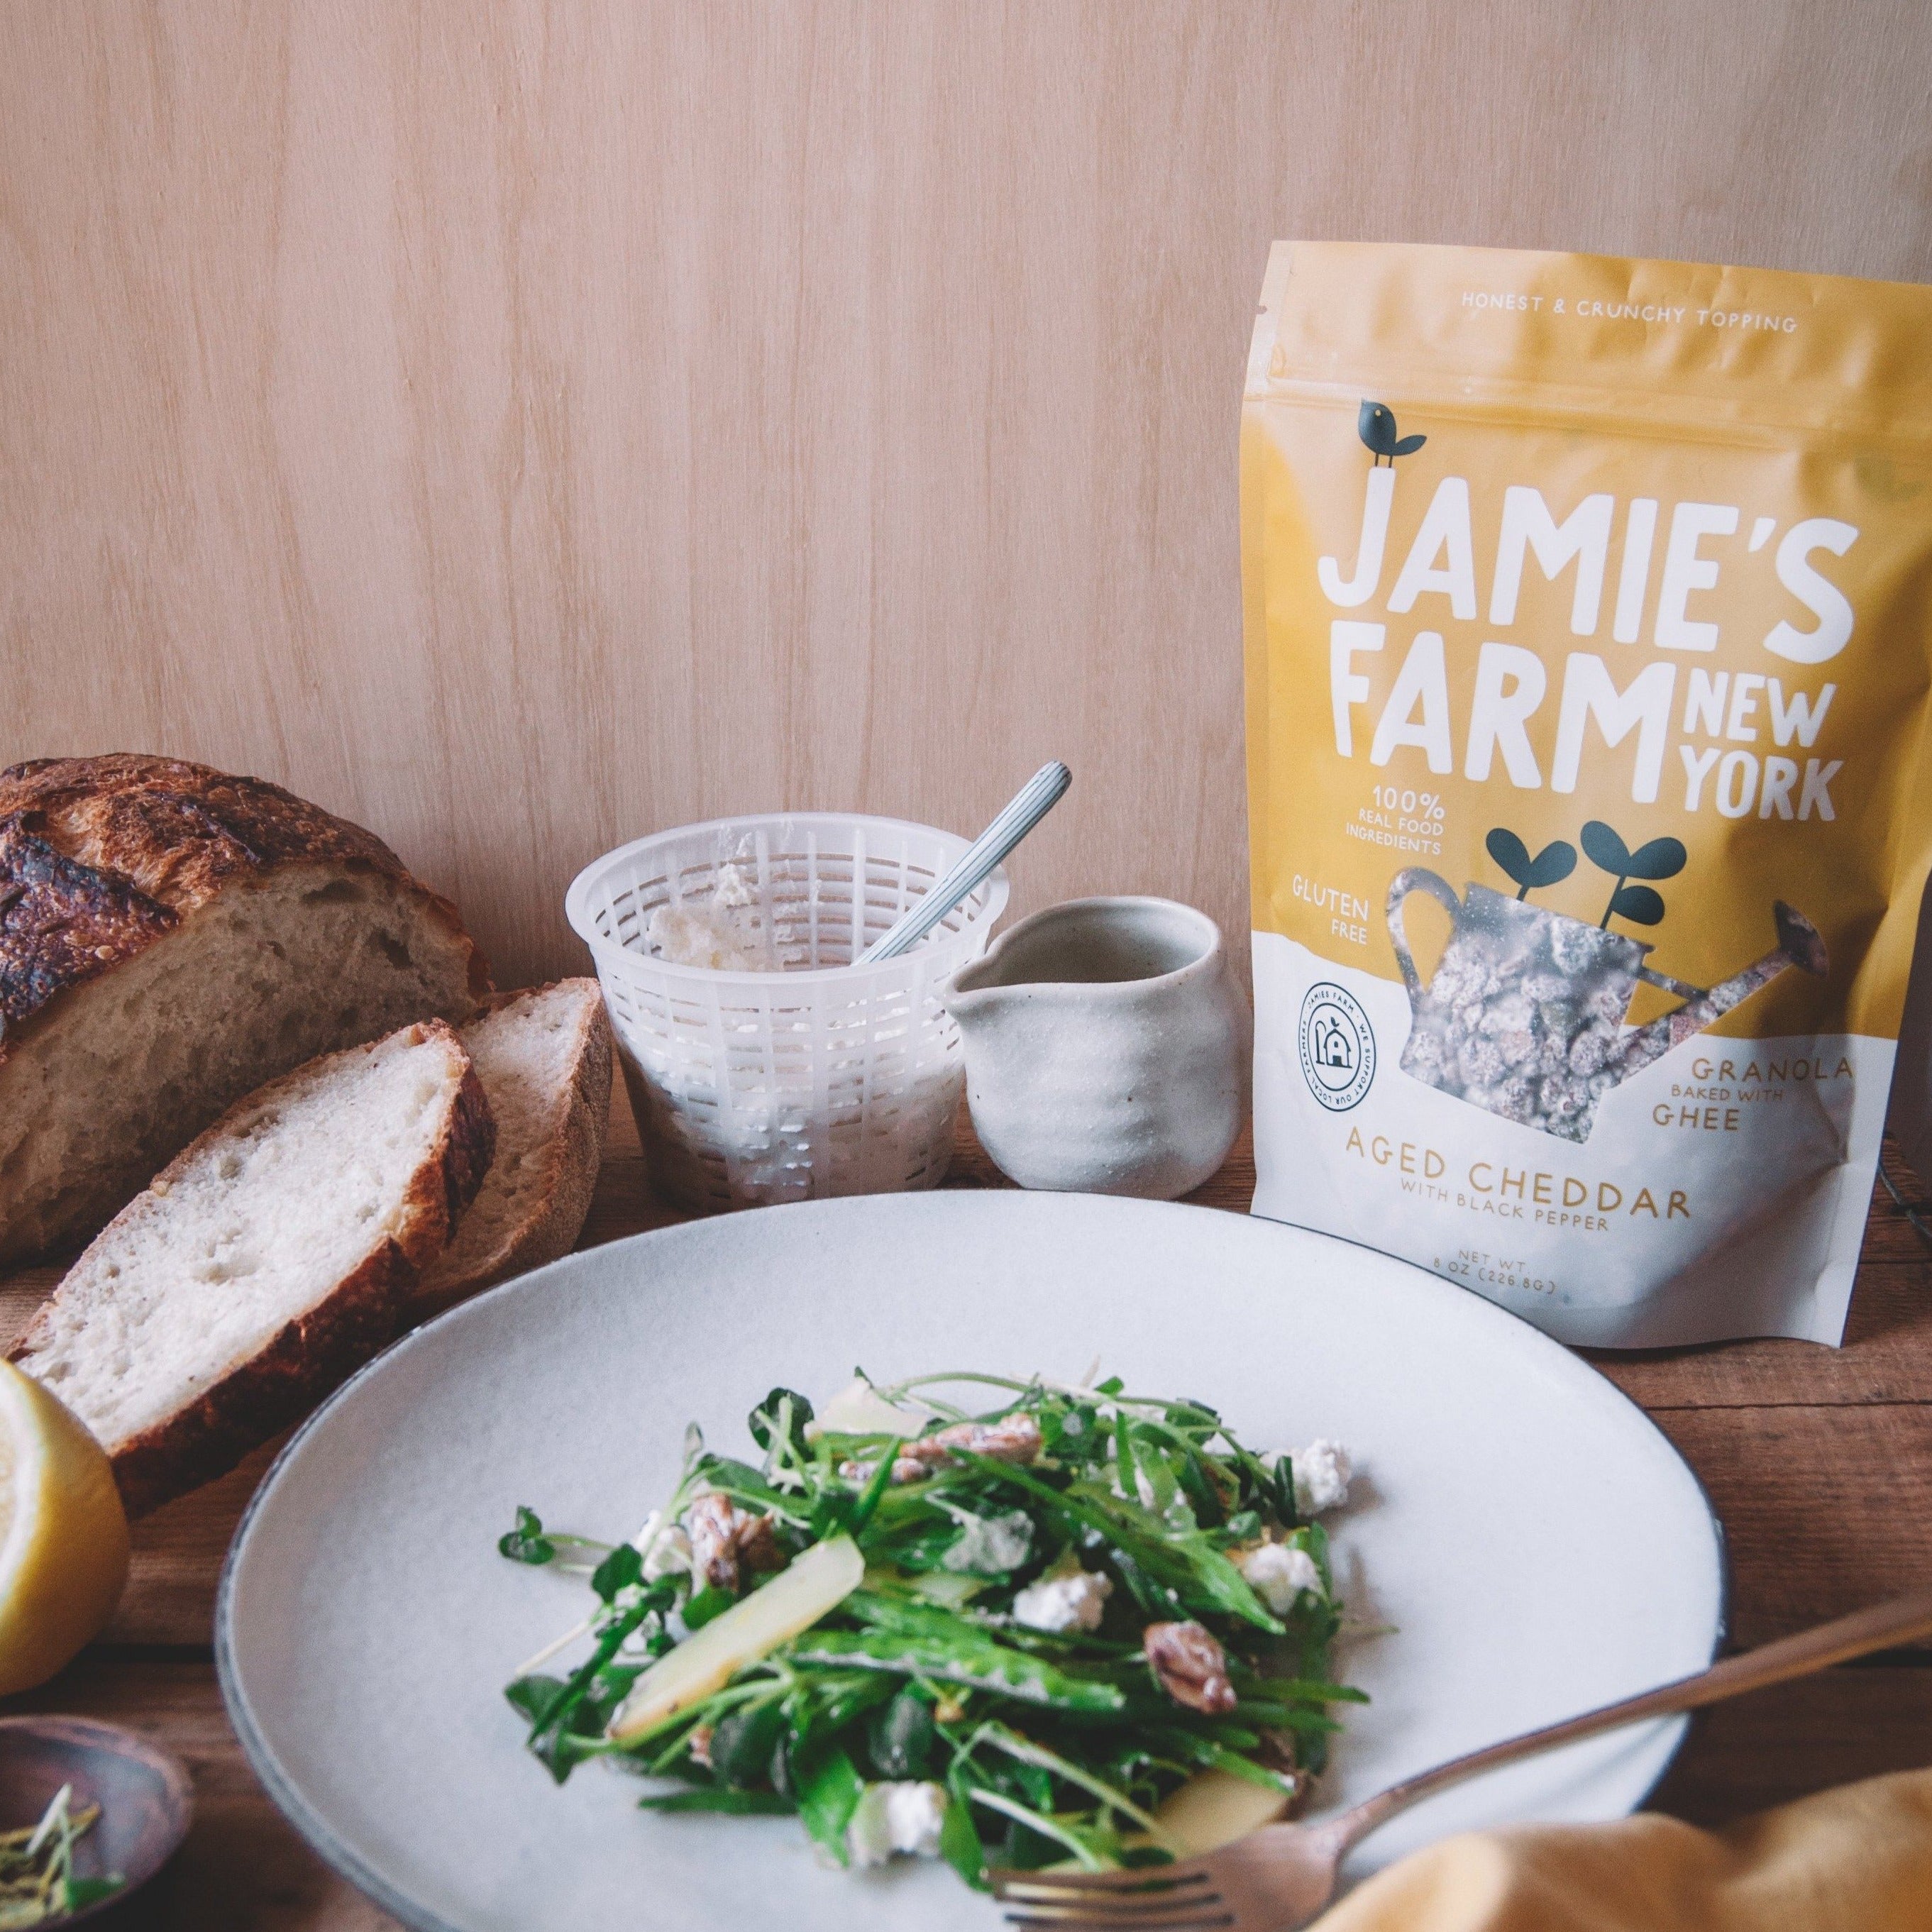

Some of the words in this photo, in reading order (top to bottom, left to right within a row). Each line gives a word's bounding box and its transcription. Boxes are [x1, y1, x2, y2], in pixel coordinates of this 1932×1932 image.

[1462, 292, 1543, 312] HONEST
[1553, 298, 1567, 314] &
[1577, 300, 1686, 324] CRUNCHY
[1696, 309, 1797, 333] TOPPING
[1318, 465, 1859, 664] JAMIE'S
[1330, 619, 1676, 804] FARM
[1684, 668, 1836, 748] NEW
[1679, 745, 1844, 822] YORK
[1373, 785, 1445, 819] 100%
[1359, 808, 1391, 829] REAL
[1398, 817, 1444, 836] FOOD
[1346, 822, 1441, 855] INGREDIENTS
[1293, 874, 1369, 922] GLUTEN
[1331, 919, 1367, 945] FREE
[1333, 992, 1354, 1012] FARM
[1359, 1024, 1369, 1041] WE
[1355, 1048, 1371, 1096] SUPPORT
[1691, 1057, 1853, 1082] GRANOLA
[1311, 1077, 1332, 1103] LOCAL
[1335, 1094, 1352, 1105] OUR
[1671, 1084, 1730, 1100] BAKED
[1738, 1089, 1784, 1101] WITH
[1652, 1103, 1740, 1131] GHEE
[1347, 1125, 1445, 1178] AGED
[1469, 1162, 1690, 1219] CHEDDAR
[1401, 1178, 1448, 1202] WITH
[1457, 1193, 1524, 1219] BLACK
[1535, 1210, 1608, 1232] PEPPER
[1433, 1257, 1440, 1268] 8
[1448, 1262, 1469, 1275] OZ
[1459, 1250, 1490, 1264] NET
